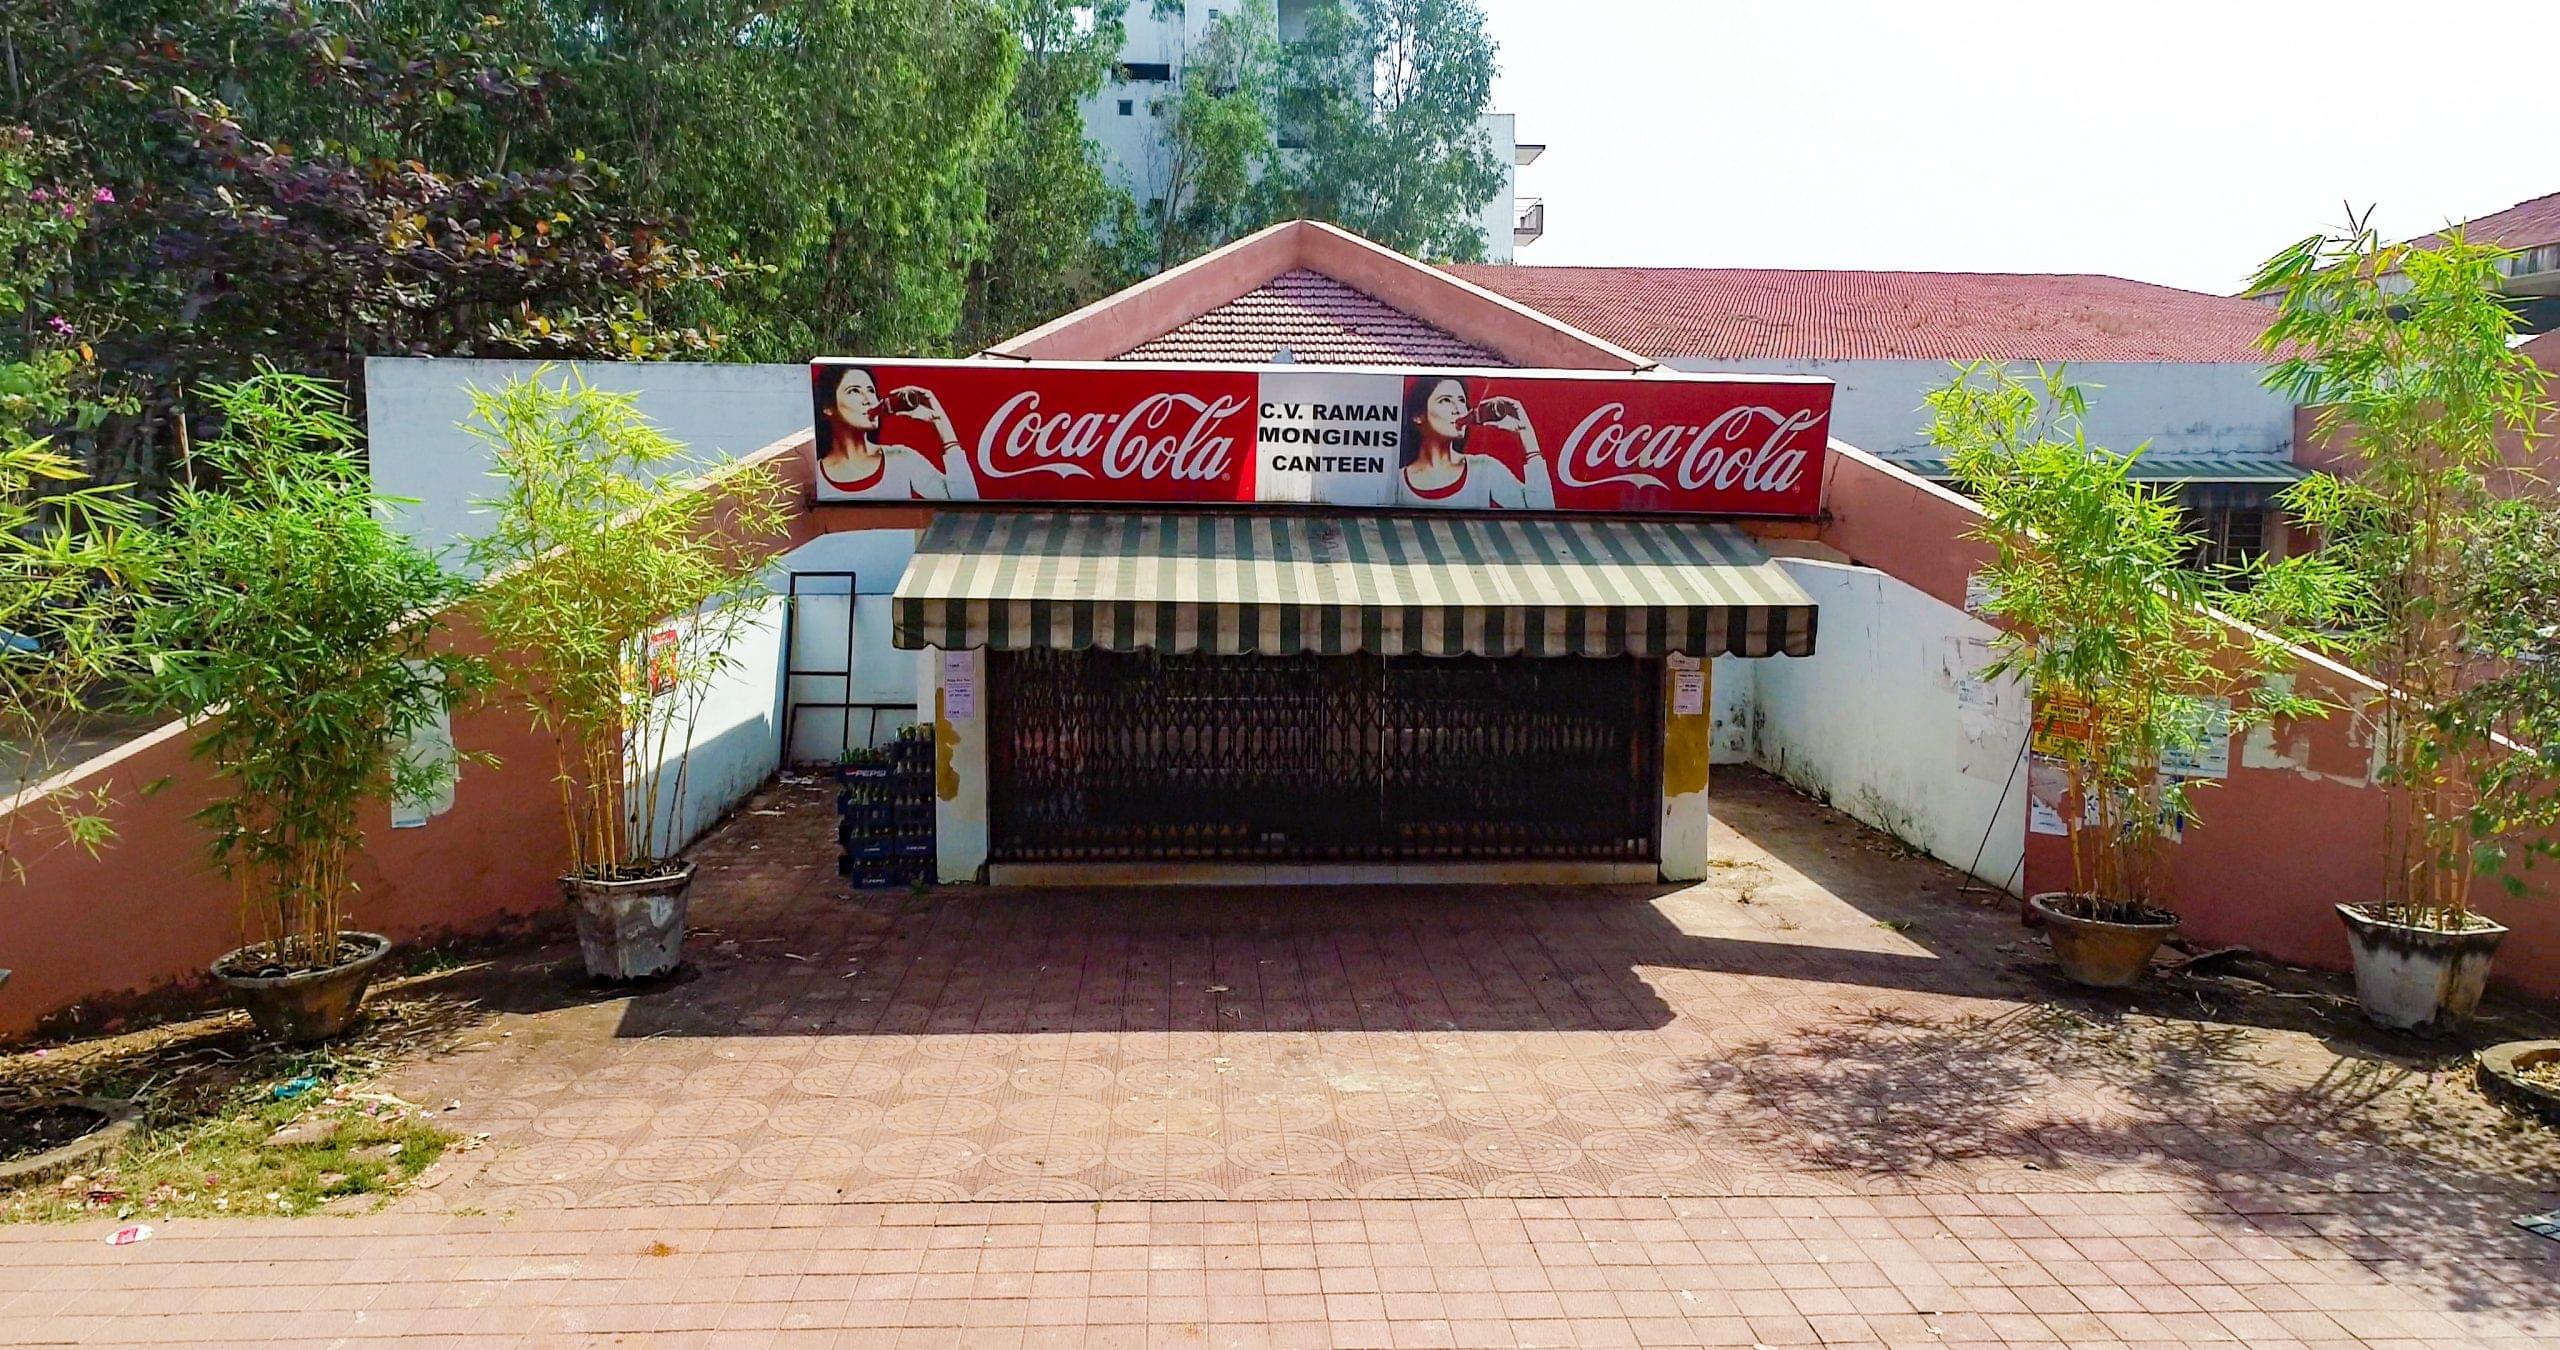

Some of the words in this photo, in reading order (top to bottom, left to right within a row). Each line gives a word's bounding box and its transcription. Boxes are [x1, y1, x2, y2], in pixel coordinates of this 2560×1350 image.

[1260, 402, 1303, 419] C.V.
[1313, 404, 1398, 421] RAMAN
[978, 391, 1251, 481] Coca-Cola
[1259, 426, 1398, 447] MONGINIS
[1558, 402, 1828, 492] Coca-Cola
[1272, 455, 1384, 473] CANTEEN
[856, 769, 886, 777] PEPSI
